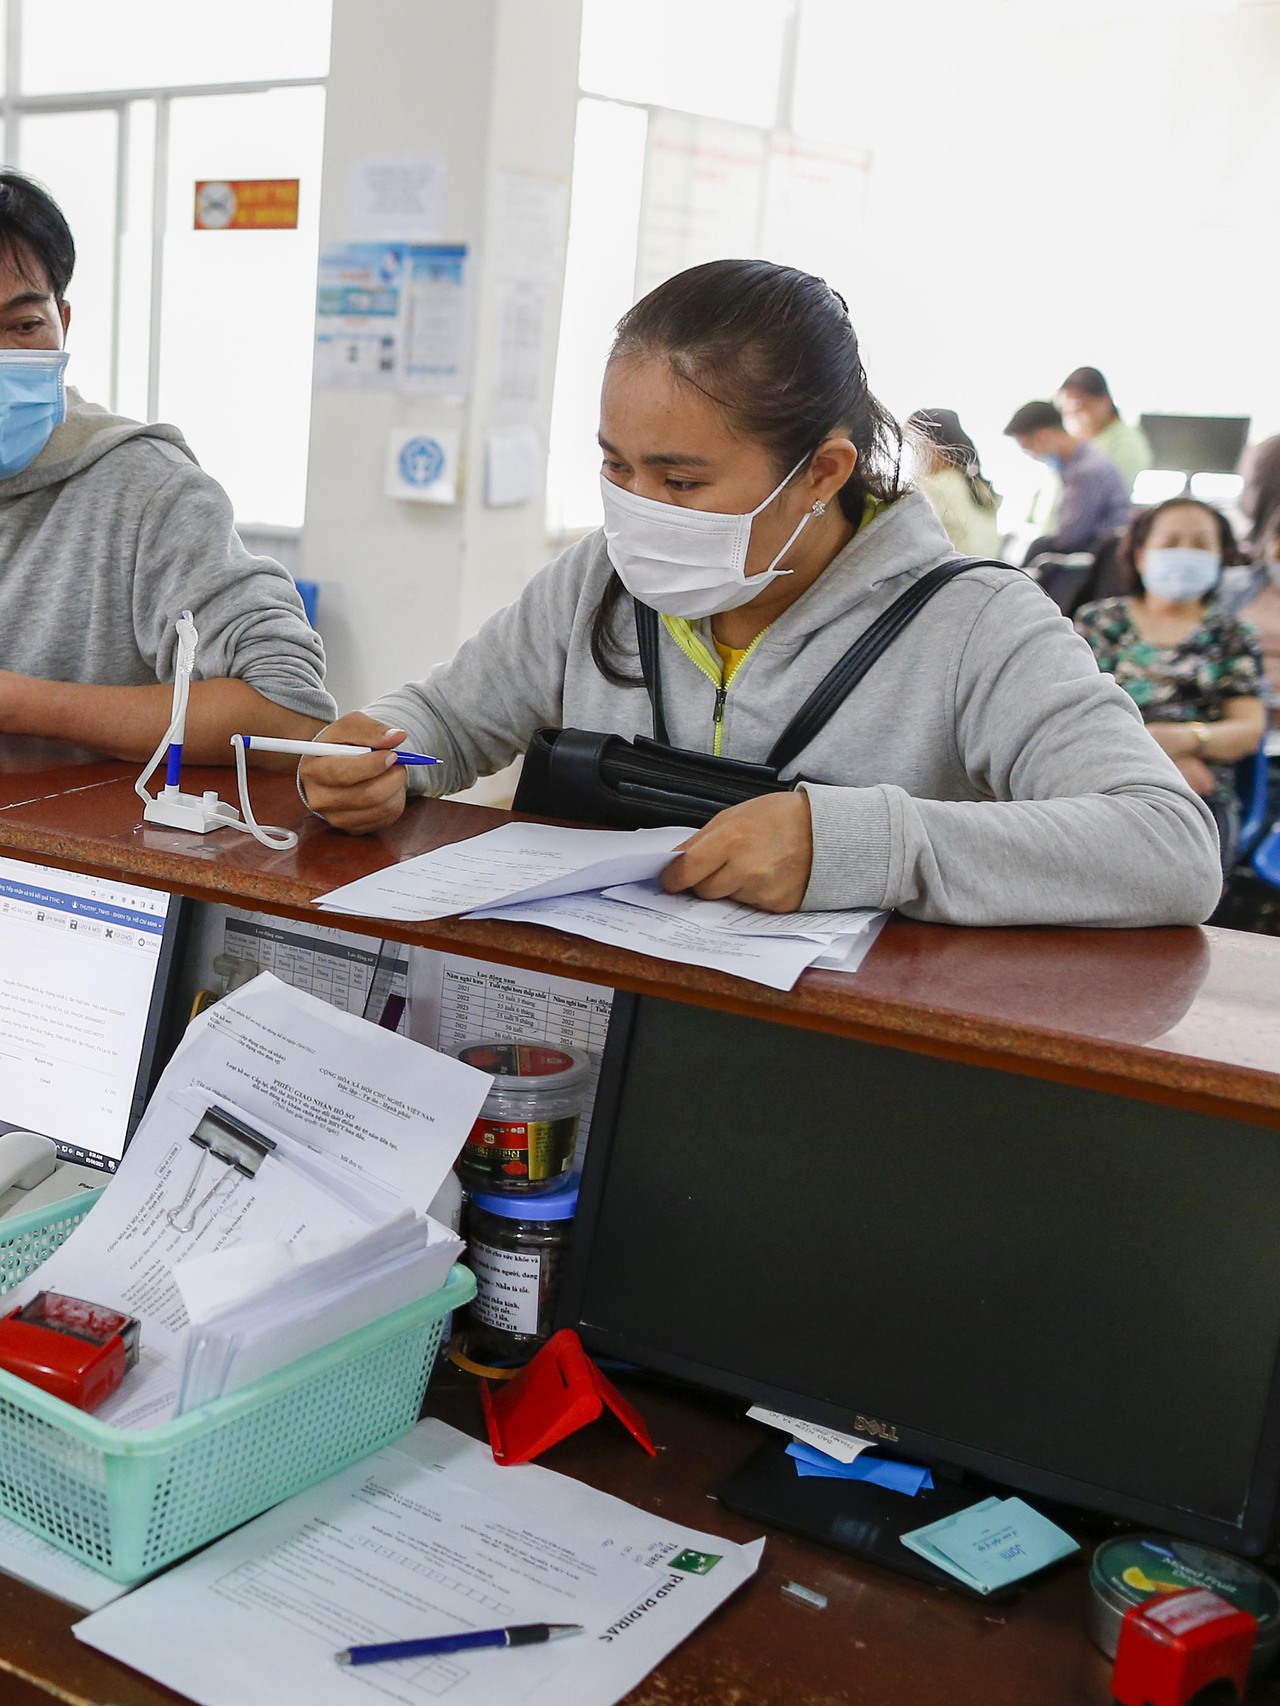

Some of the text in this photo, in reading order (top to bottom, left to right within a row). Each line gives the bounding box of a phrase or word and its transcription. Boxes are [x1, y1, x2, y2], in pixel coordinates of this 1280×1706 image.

[446, 972, 484, 986] Năm nghỉ hưu
[489, 974, 503, 984] động
[457, 984, 470, 992] 2021
[489, 981, 547, 1000] Tuổi nghỉ hưu thấp nhất
[521, 998, 536, 1007] tháng
[553, 996, 588, 1009] Năm nghỉ hưu
[521, 1008, 535, 1017] tháng
[562, 1008, 575, 1016] 2021
[520, 1018, 534, 1027] tháng
[562, 1018, 574, 1026] 2022
[561, 1028, 573, 1036] 2023
[560, 1037, 572, 1046] 2024
[273, 1079, 293, 1093] PHIẾU
[294, 1090, 310, 1101] GIAO
[311, 1097, 333, 1112] NHẬN
[422, 1113, 434, 1121] NAM
[505, 1301, 520, 1309] kinh,
[854, 1415, 898, 1442] DELL
